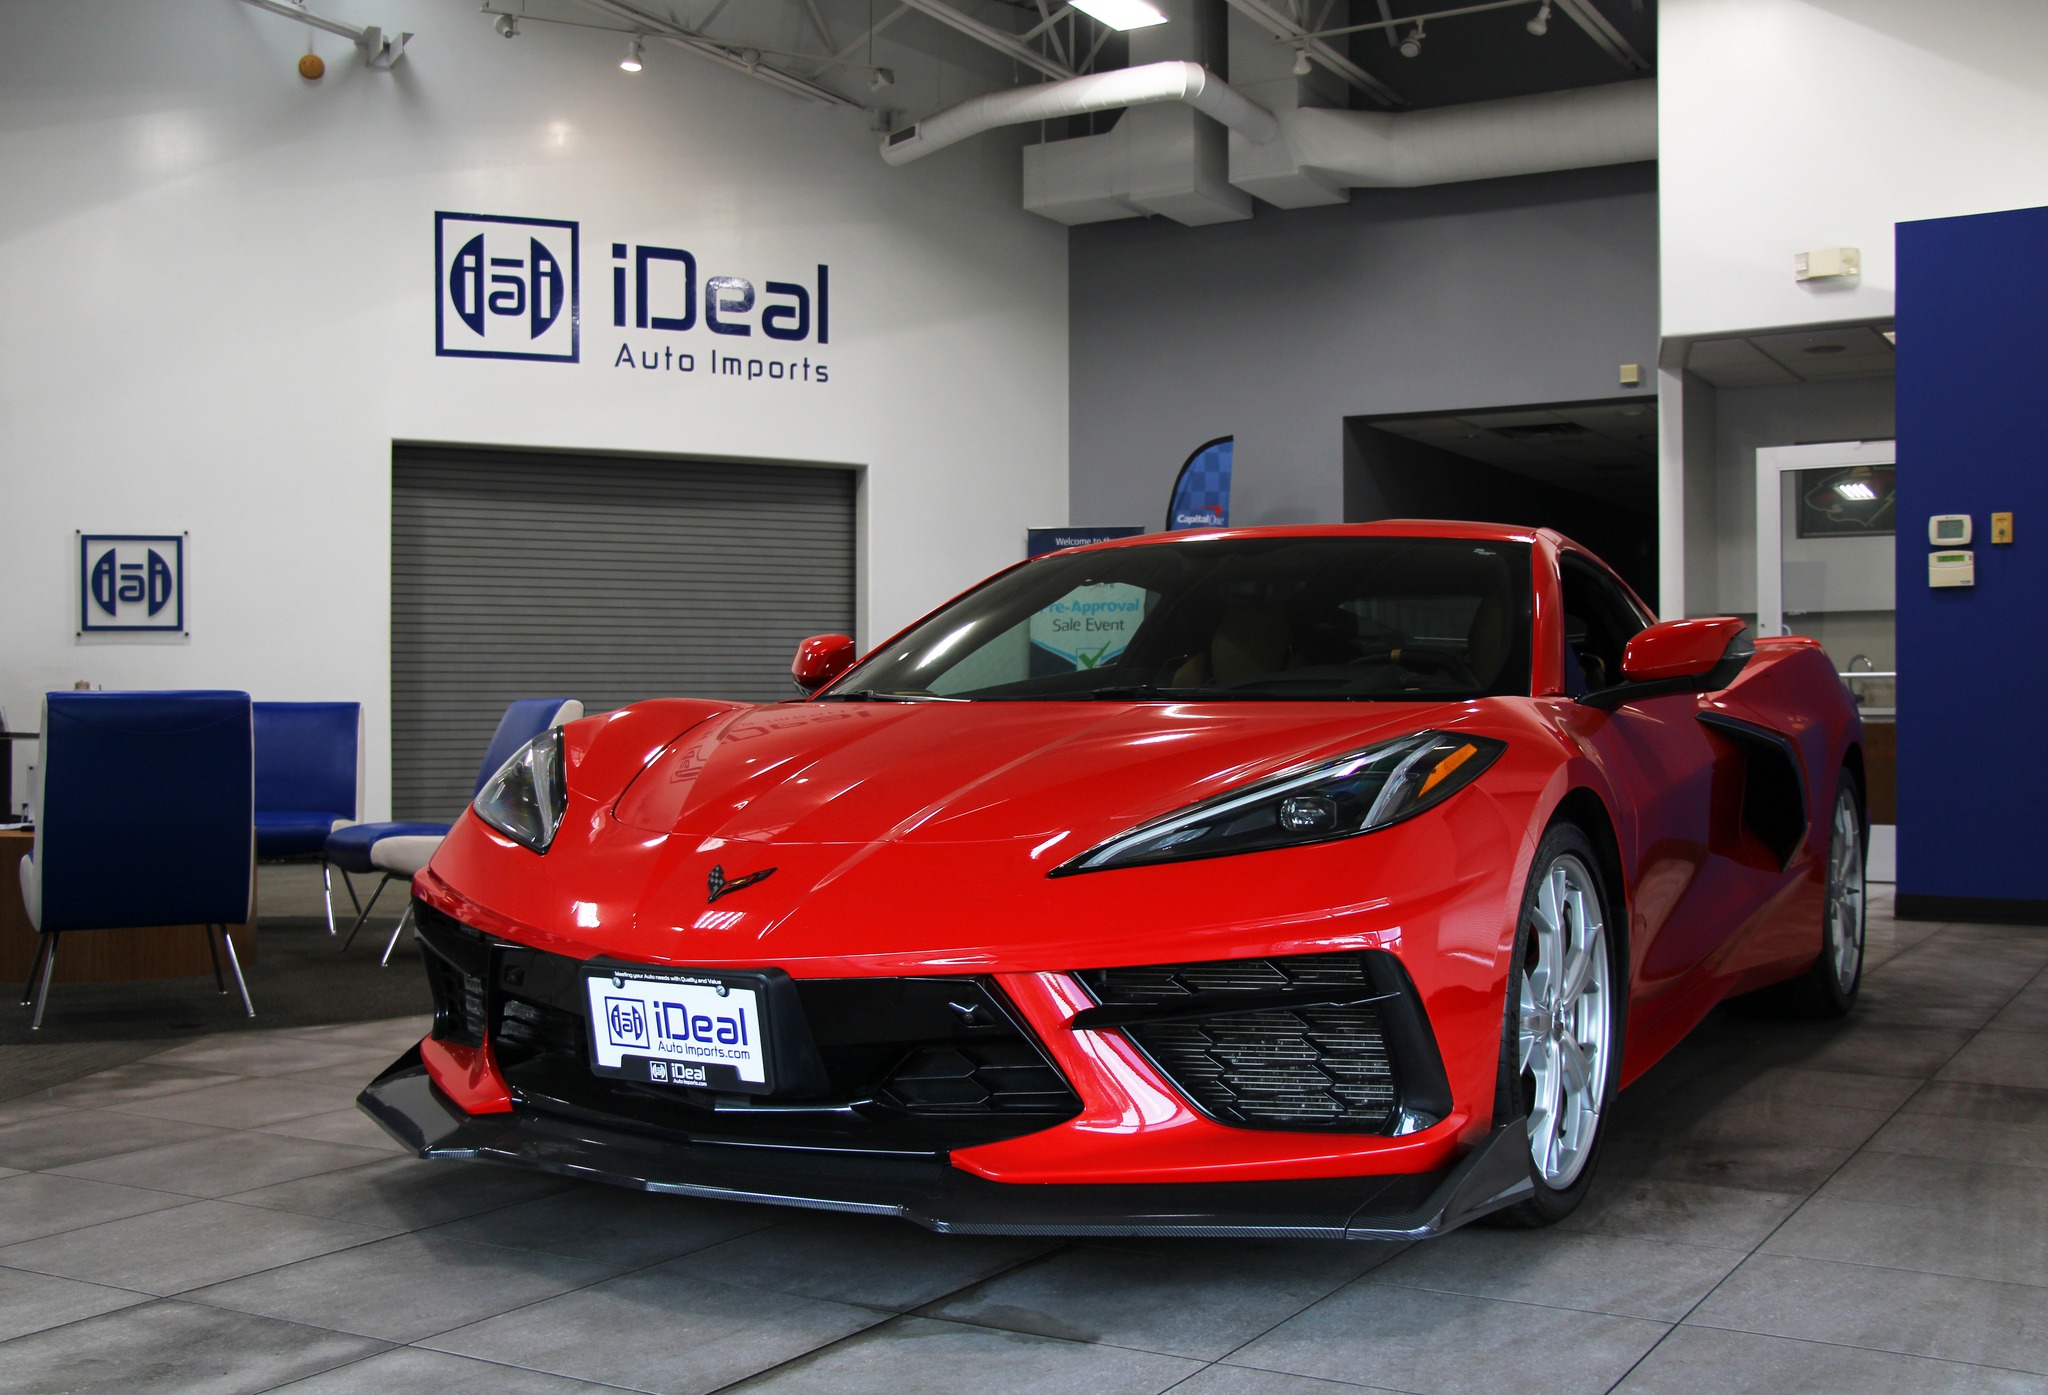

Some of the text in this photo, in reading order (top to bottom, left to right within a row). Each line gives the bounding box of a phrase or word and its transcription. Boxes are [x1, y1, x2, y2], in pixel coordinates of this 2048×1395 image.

[611, 242, 830, 345] iDeal
[614, 342, 830, 383] Auto Imports
[1055, 537, 1092, 546] Welcome
[1046, 597, 1140, 617] re-Approval
[1052, 617, 1126, 632] Sale Event
[680, 976, 698, 984] Quality
[653, 1000, 749, 1046] iDeal
[658, 1040, 751, 1060] Auto Imports.com
[670, 1062, 706, 1081] iDeal
